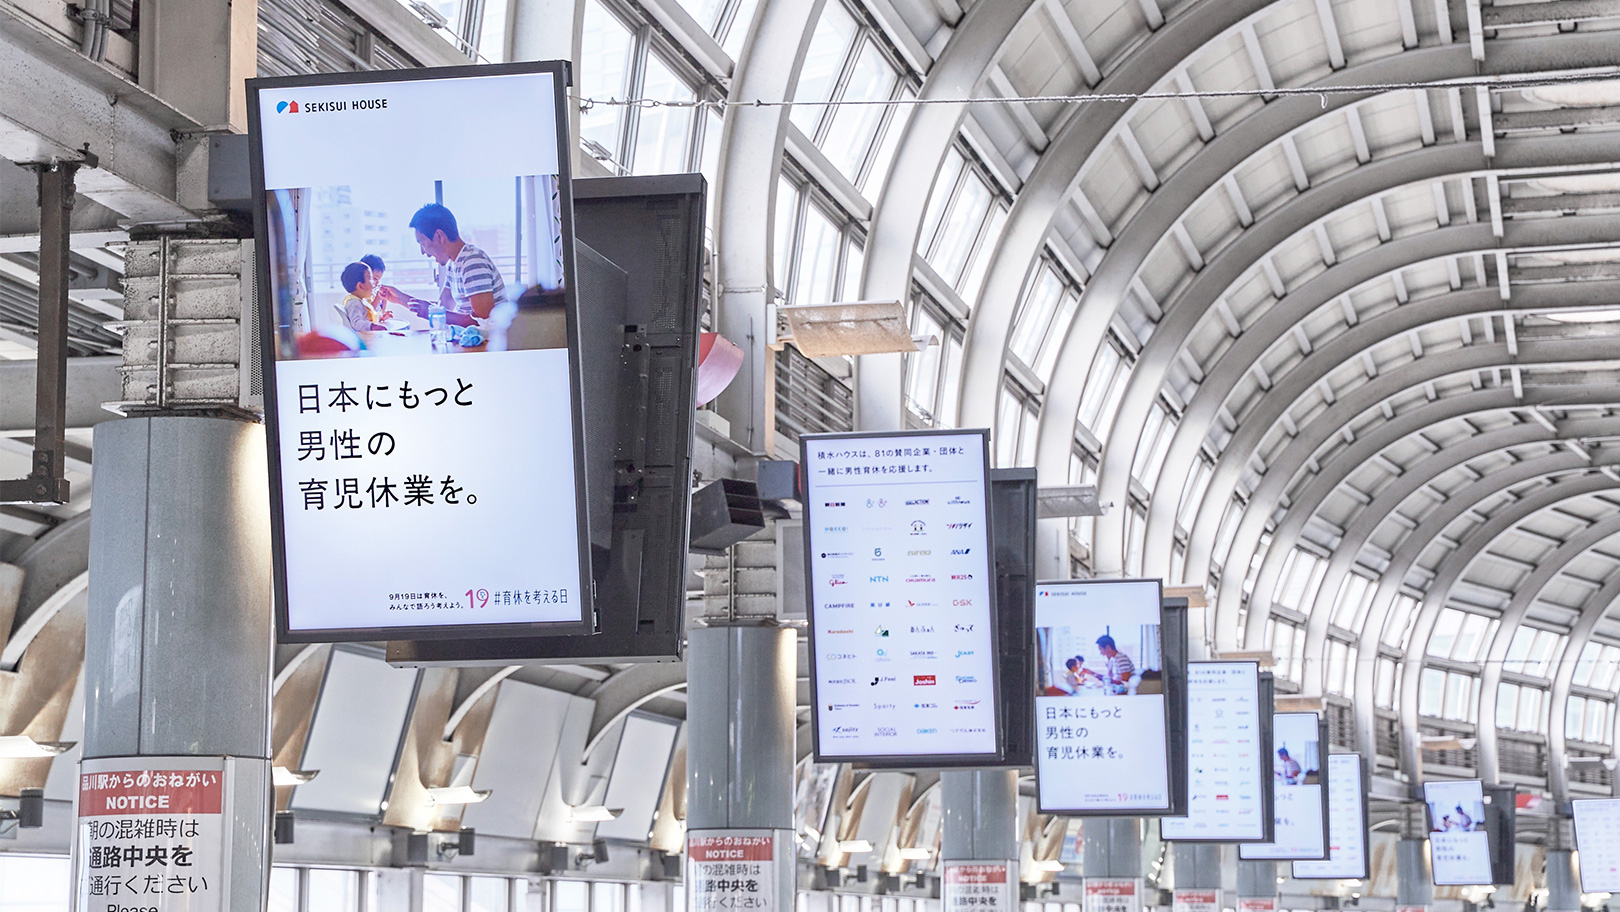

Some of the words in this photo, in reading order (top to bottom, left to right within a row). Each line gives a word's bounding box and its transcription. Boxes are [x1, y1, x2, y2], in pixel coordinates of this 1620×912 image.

[304, 101, 347, 113] SEKISUI
[351, 99, 388, 110] HOUSE
[298, 378, 473, 414] 日本にもっと
[297, 428, 396, 461] 男性の
[298, 474, 477, 511] 育児休業を。
[388, 592, 448, 601] 9月19日は育休を、
[494, 588, 568, 606] #育休を考える日
[1046, 706, 1122, 719] 日本にもっと
[1045, 725, 1089, 740] 男性の
[1046, 745, 1124, 760] 育児休業を。
[82, 772, 217, 791] 品川駅からのおねがい
[105, 795, 170, 810] NOTICE
[89, 844, 194, 869] 通路中央を
[705, 849, 745, 859] NOTICE
